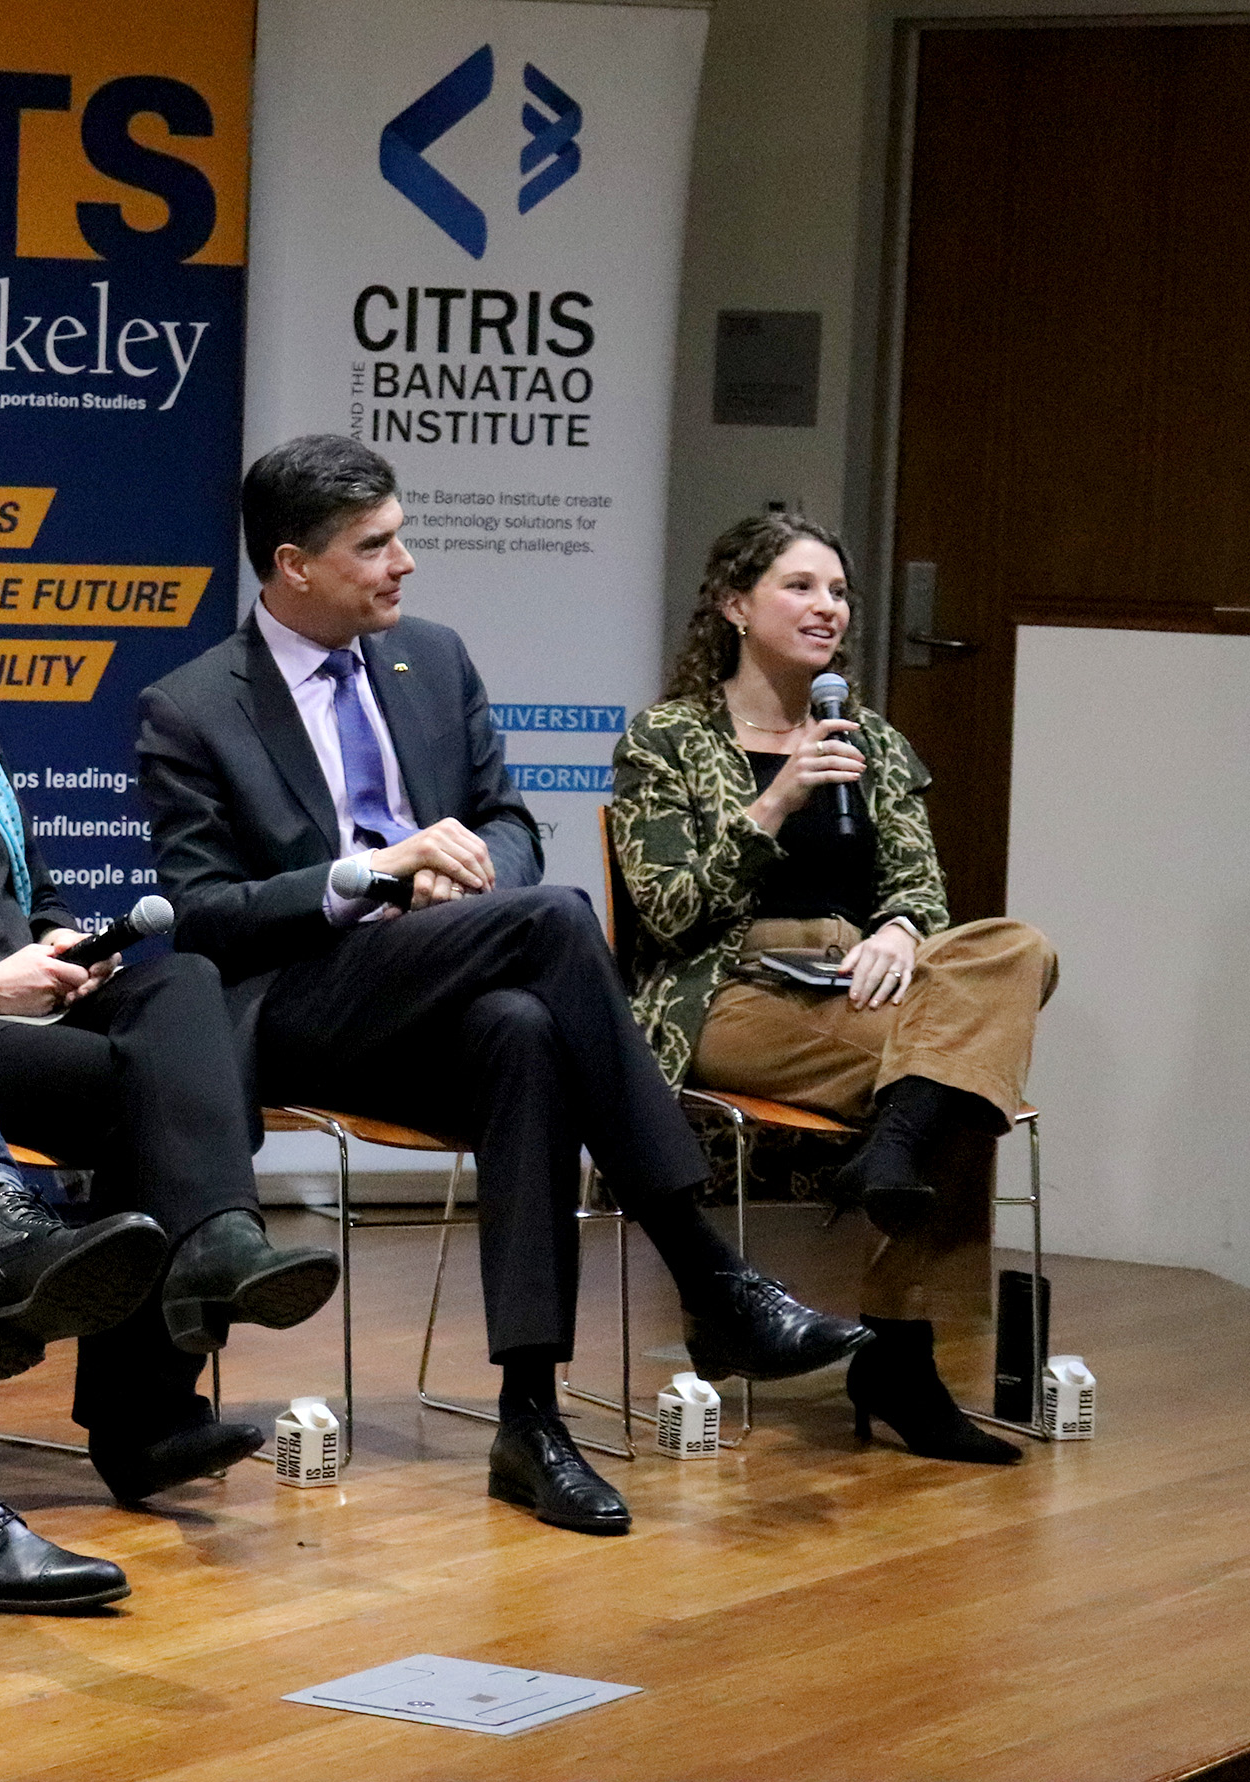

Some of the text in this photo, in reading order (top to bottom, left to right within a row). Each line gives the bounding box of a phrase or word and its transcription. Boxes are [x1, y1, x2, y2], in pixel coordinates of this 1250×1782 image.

[353, 285, 595, 358] CITRIS
[351, 361, 366, 440] AND THE
[373, 362, 593, 403] BANATAO
[82, 393, 147, 410] Studies
[371, 409, 591, 447] INSTITUTE
[406, 490, 431, 504] the
[434, 490, 495, 505] Banatao
[499, 491, 561, 507] Institute
[565, 494, 613, 508] create
[422, 514, 500, 532] technology
[505, 516, 573, 530] solutions
[576, 516, 597, 530] for
[405, 537, 594, 556] most pressing challenges.
[32, 579, 181, 613] FUTURE
[13, 767, 139, 793] ps leading-
[33, 815, 152, 841] influencing
[50, 863, 158, 889] people an
[658, 1409, 670, 1448] BOXED
[669, 1411, 683, 1451] WATER
[703, 1408, 718, 1452] BETTER
[276, 1436, 288, 1476] BOXED
[288, 1438, 301, 1479] WATER
[322, 1432, 337, 1479] BETTER
[686, 1441, 702, 1453] IS
[306, 1468, 322, 1480] IS
